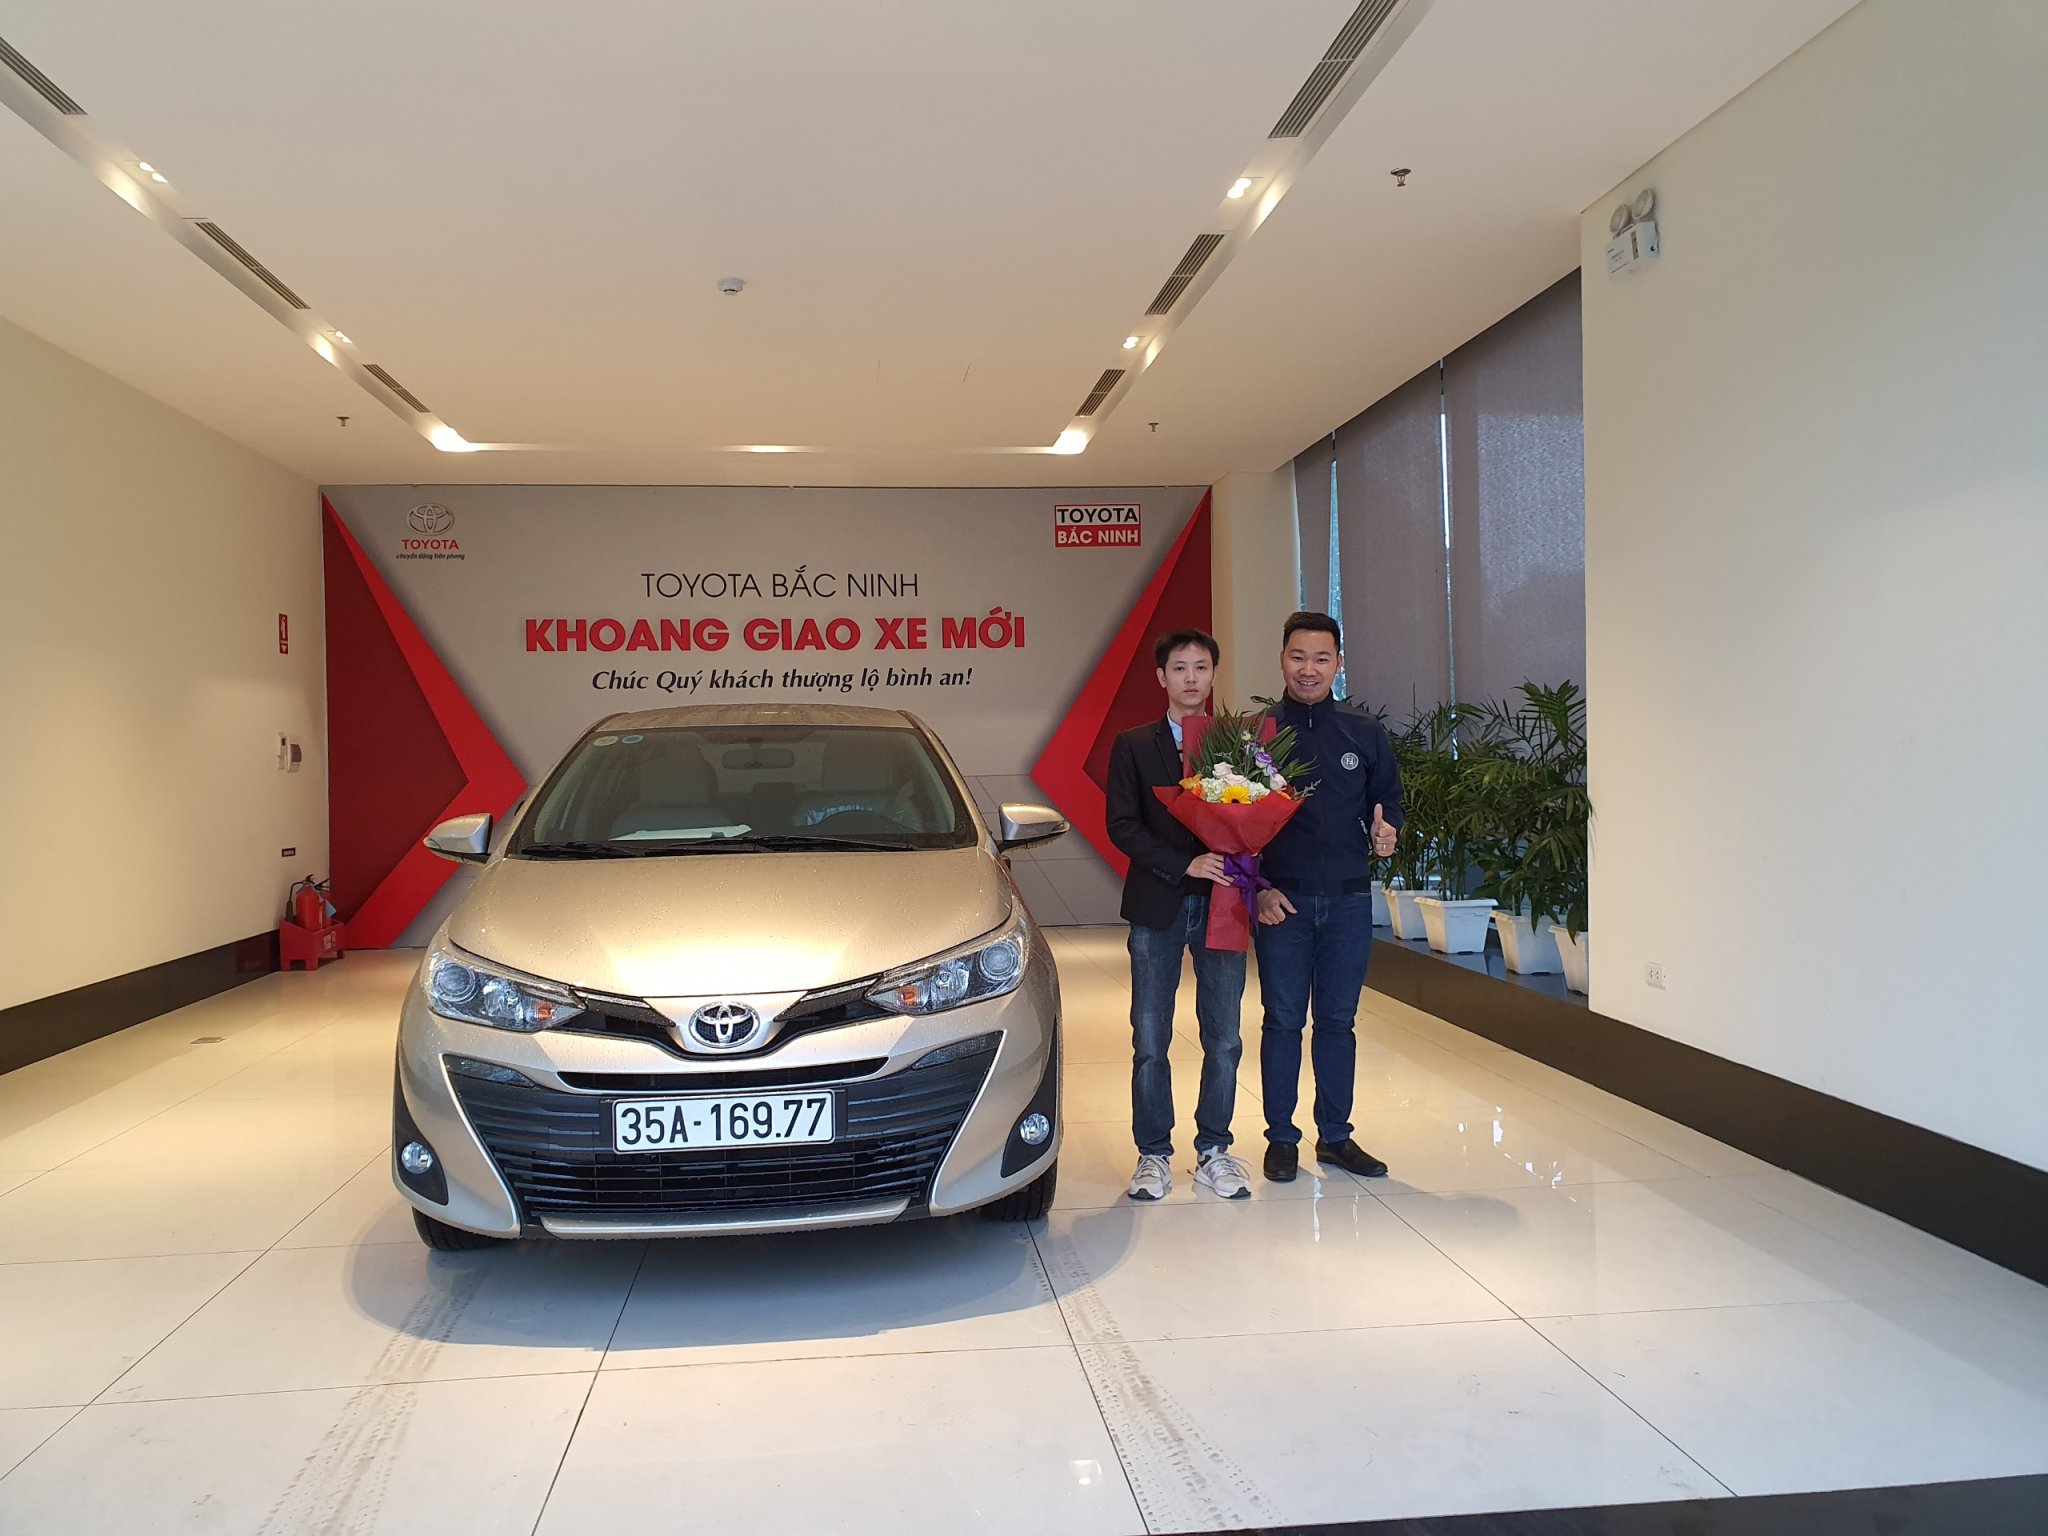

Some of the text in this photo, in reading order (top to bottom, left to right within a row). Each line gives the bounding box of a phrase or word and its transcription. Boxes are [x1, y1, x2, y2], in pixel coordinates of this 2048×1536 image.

[1057, 508, 1138, 523] TOYOTA
[401, 539, 460, 550] TOYOTA
[1057, 526, 1138, 544] BẮC NINH
[641, 564, 919, 598] TOYOTA BẮC NINH
[525, 606, 1026, 652] KHOANG GIAO XE MỚI
[591, 667, 972, 694] Chúc Quý khách thượng lộ bình an!
[621, 1097, 828, 1145] 35A-169.77
